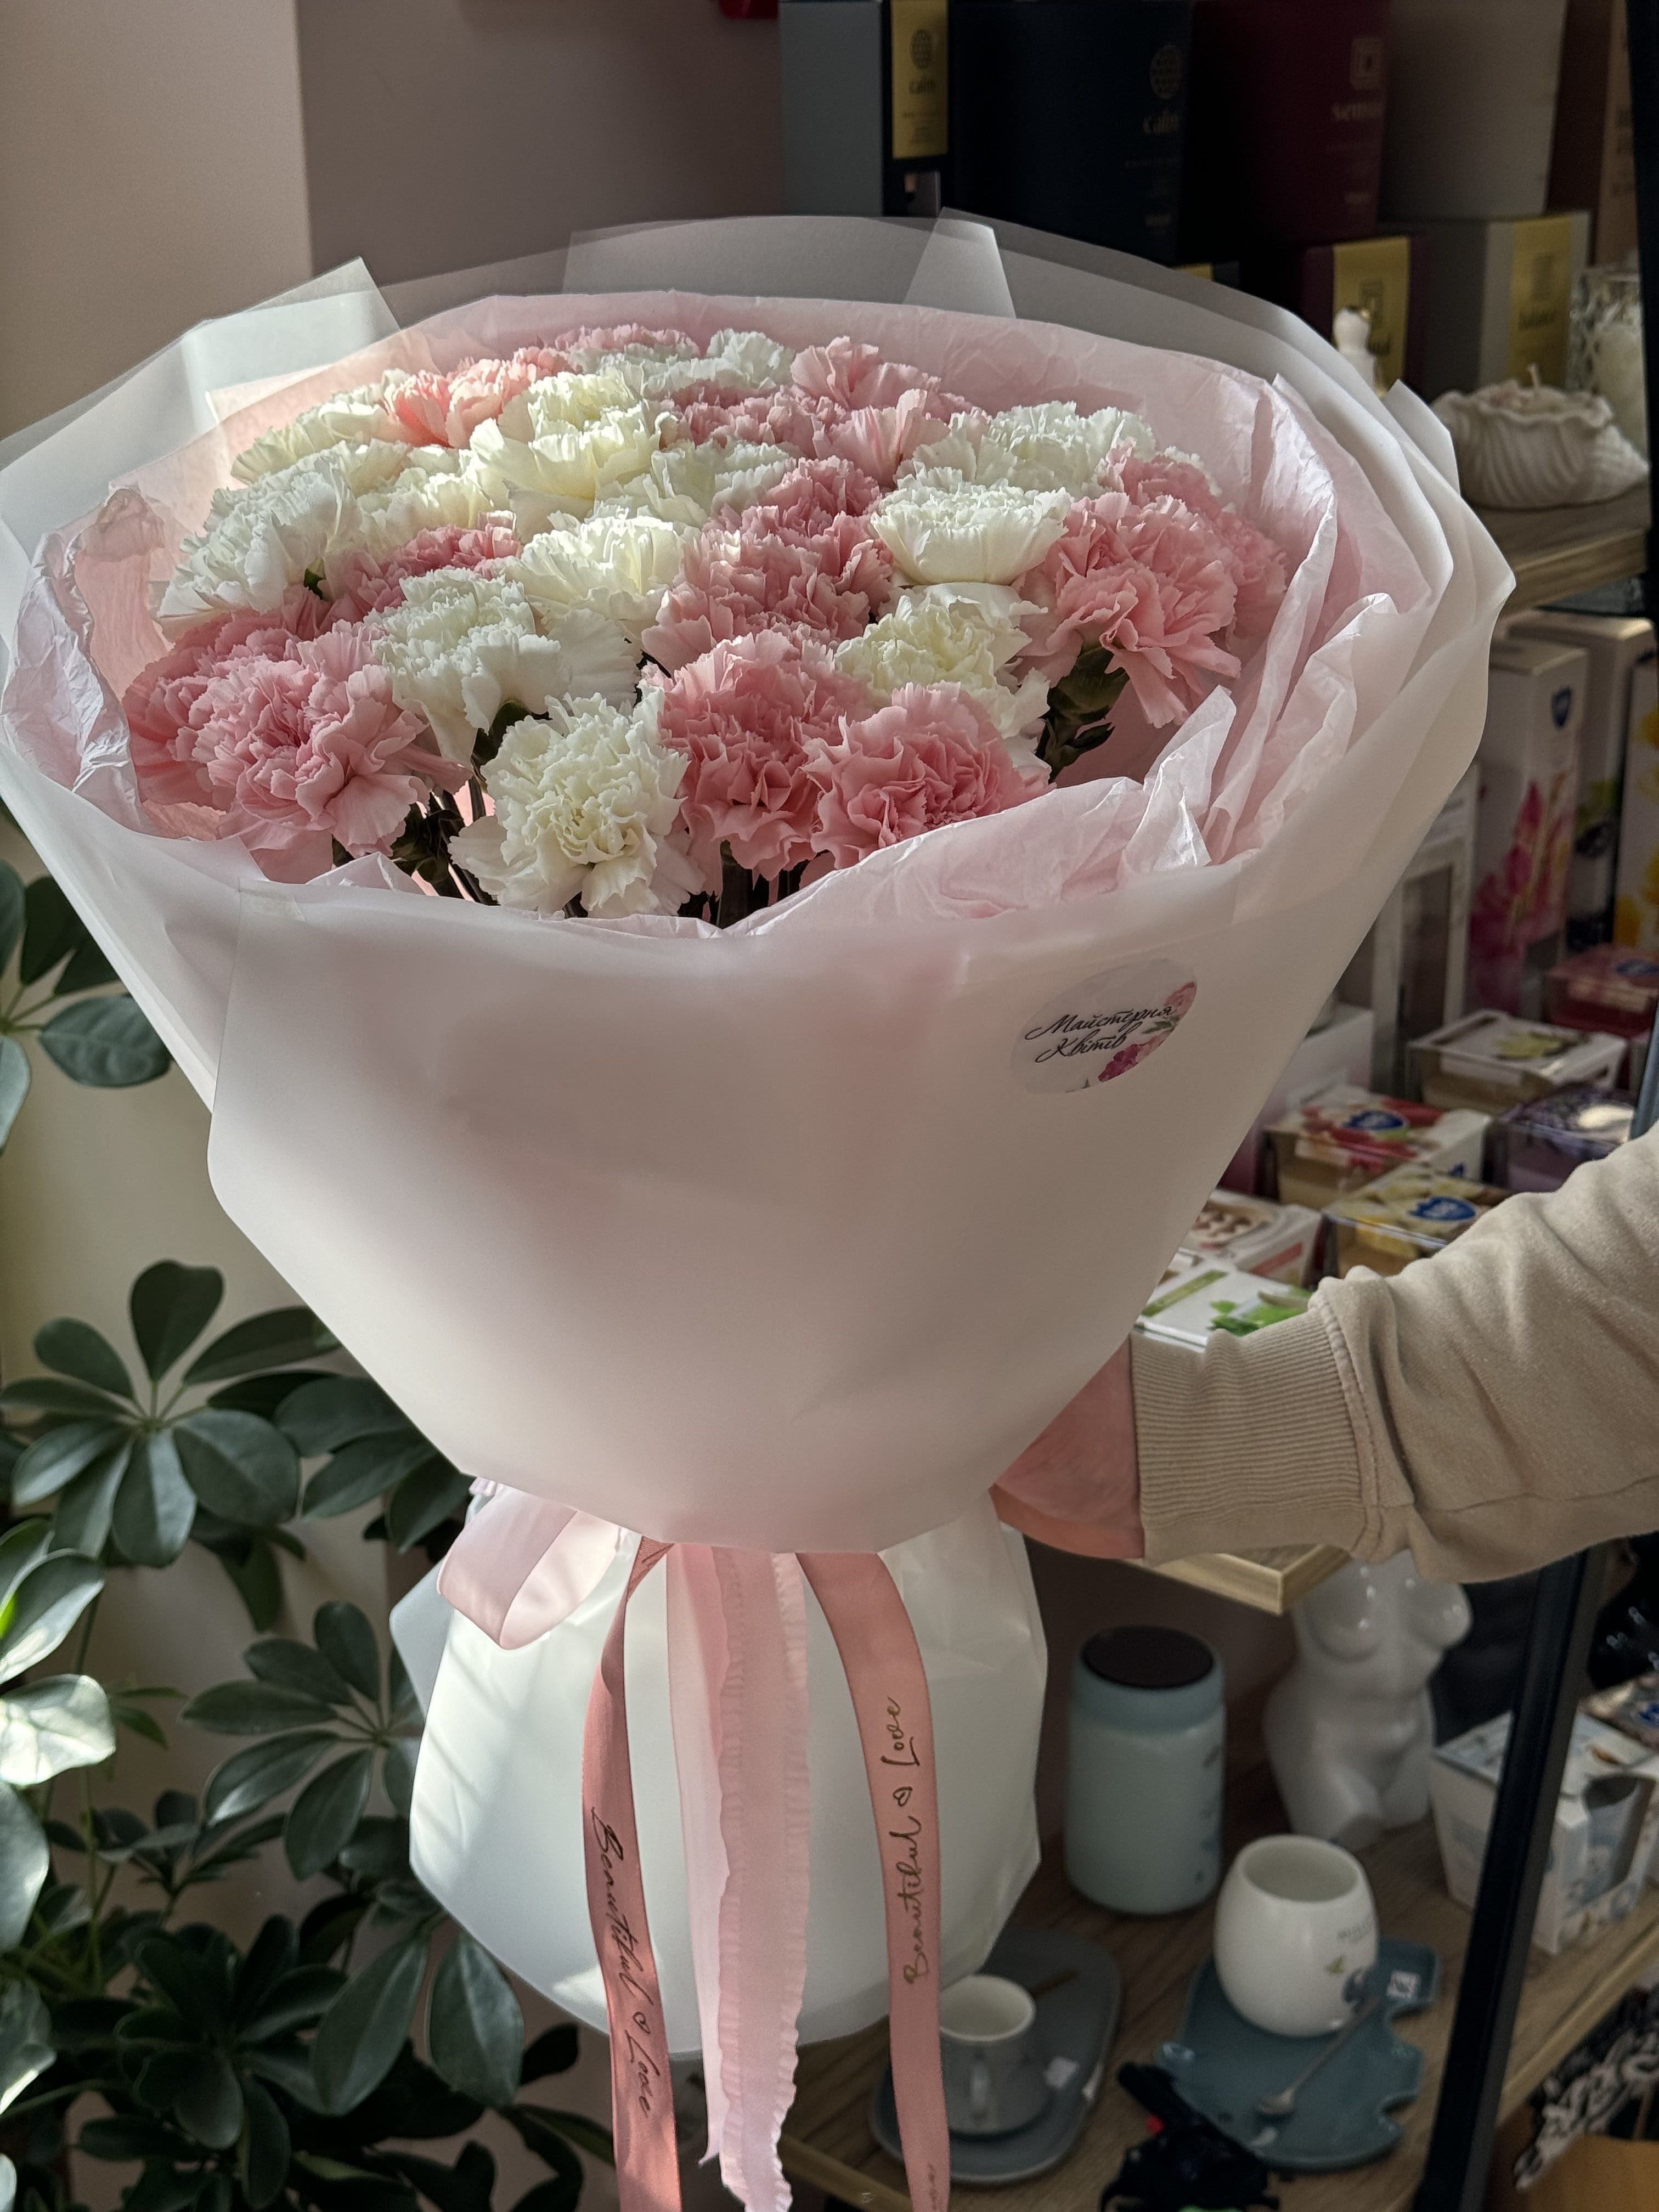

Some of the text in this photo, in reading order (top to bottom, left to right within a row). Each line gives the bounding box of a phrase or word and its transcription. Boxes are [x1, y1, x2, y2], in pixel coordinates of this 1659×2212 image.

[1025, 1006, 1175, 1040] Майстерня
[1035, 1021, 1143, 1063] Квітів
[880, 1696, 929, 1984] Beautiful Love
[590, 1806, 660, 2118] Beautiful Love
